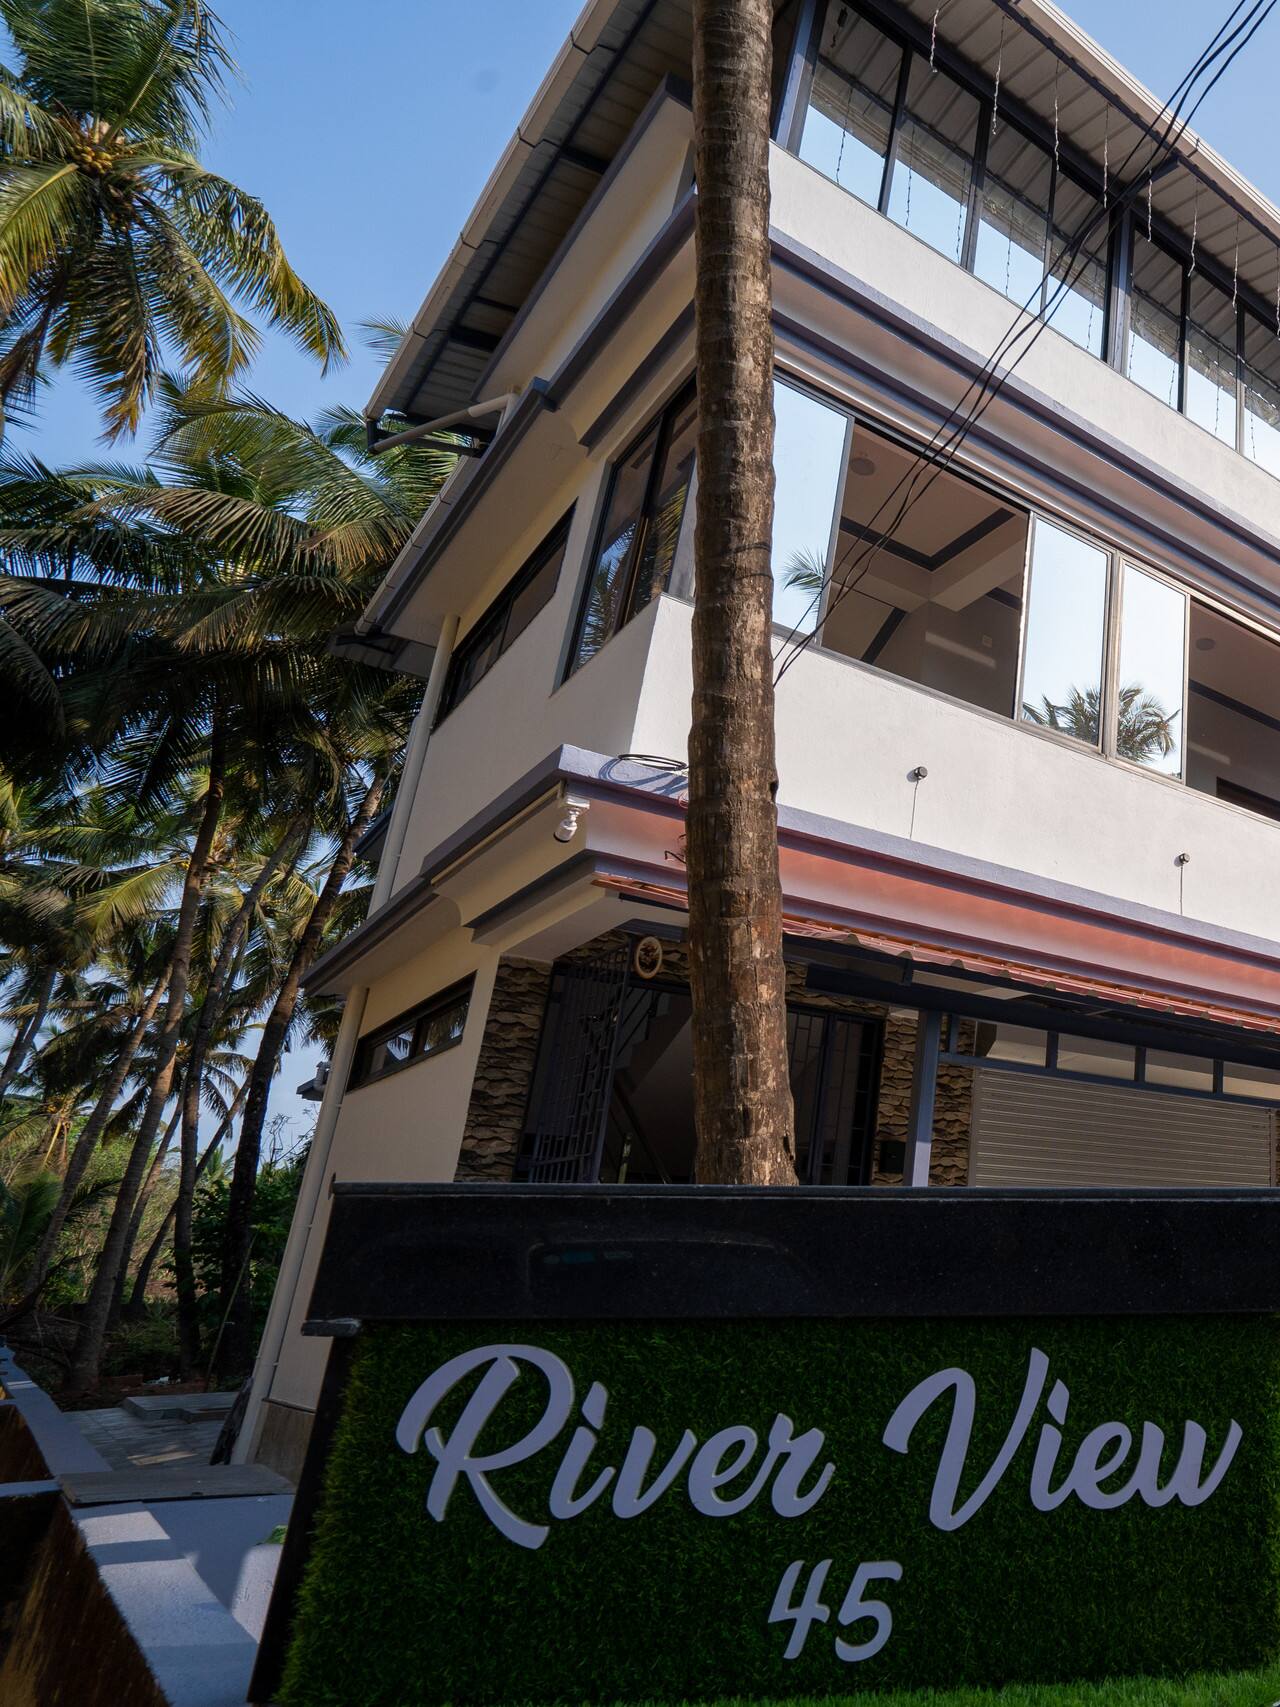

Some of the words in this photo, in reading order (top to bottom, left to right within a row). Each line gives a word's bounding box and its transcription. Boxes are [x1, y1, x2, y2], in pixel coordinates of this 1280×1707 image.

[396, 1344, 836, 1549] River
[882, 1347, 1243, 1531] View
[767, 1559, 904, 1662] 45
